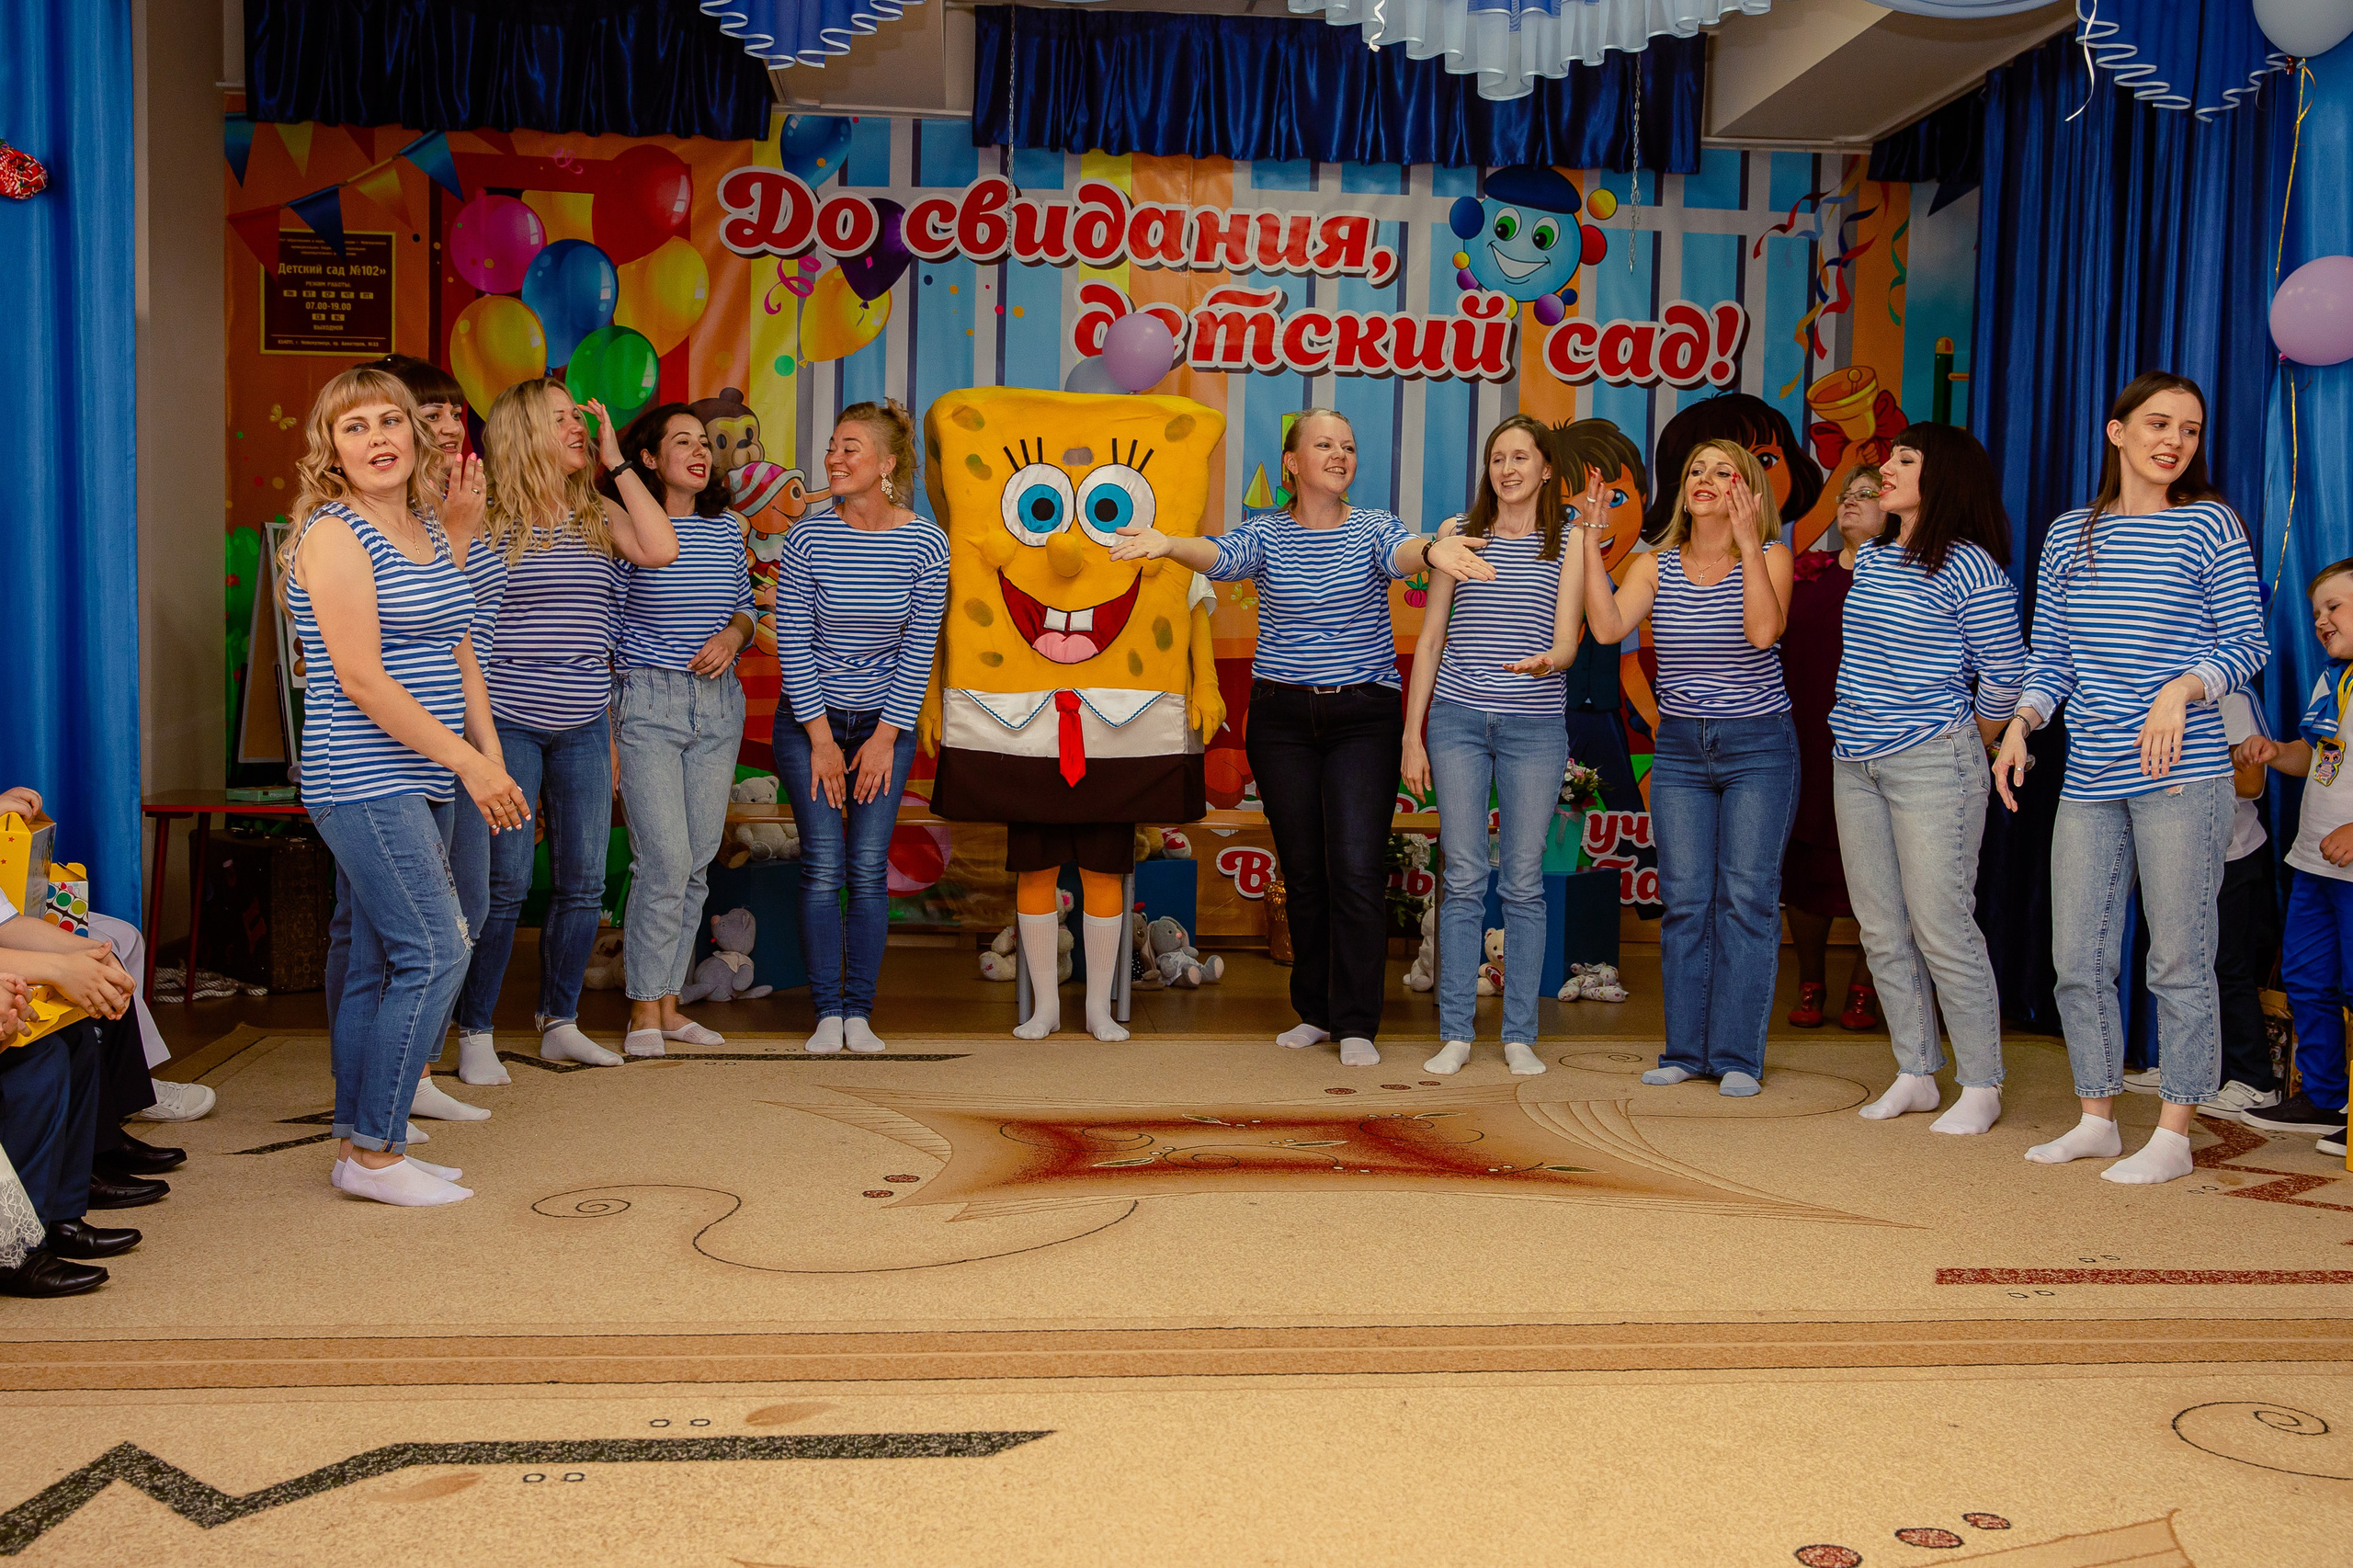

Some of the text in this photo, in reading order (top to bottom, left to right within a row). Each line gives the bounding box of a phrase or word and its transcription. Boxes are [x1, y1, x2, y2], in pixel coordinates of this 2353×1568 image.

[720, 172, 1397, 284] До свидания,
[278, 263, 323, 276] Детский
[326, 265, 346, 277] сад
[1547, 303, 1741, 381] сад!
